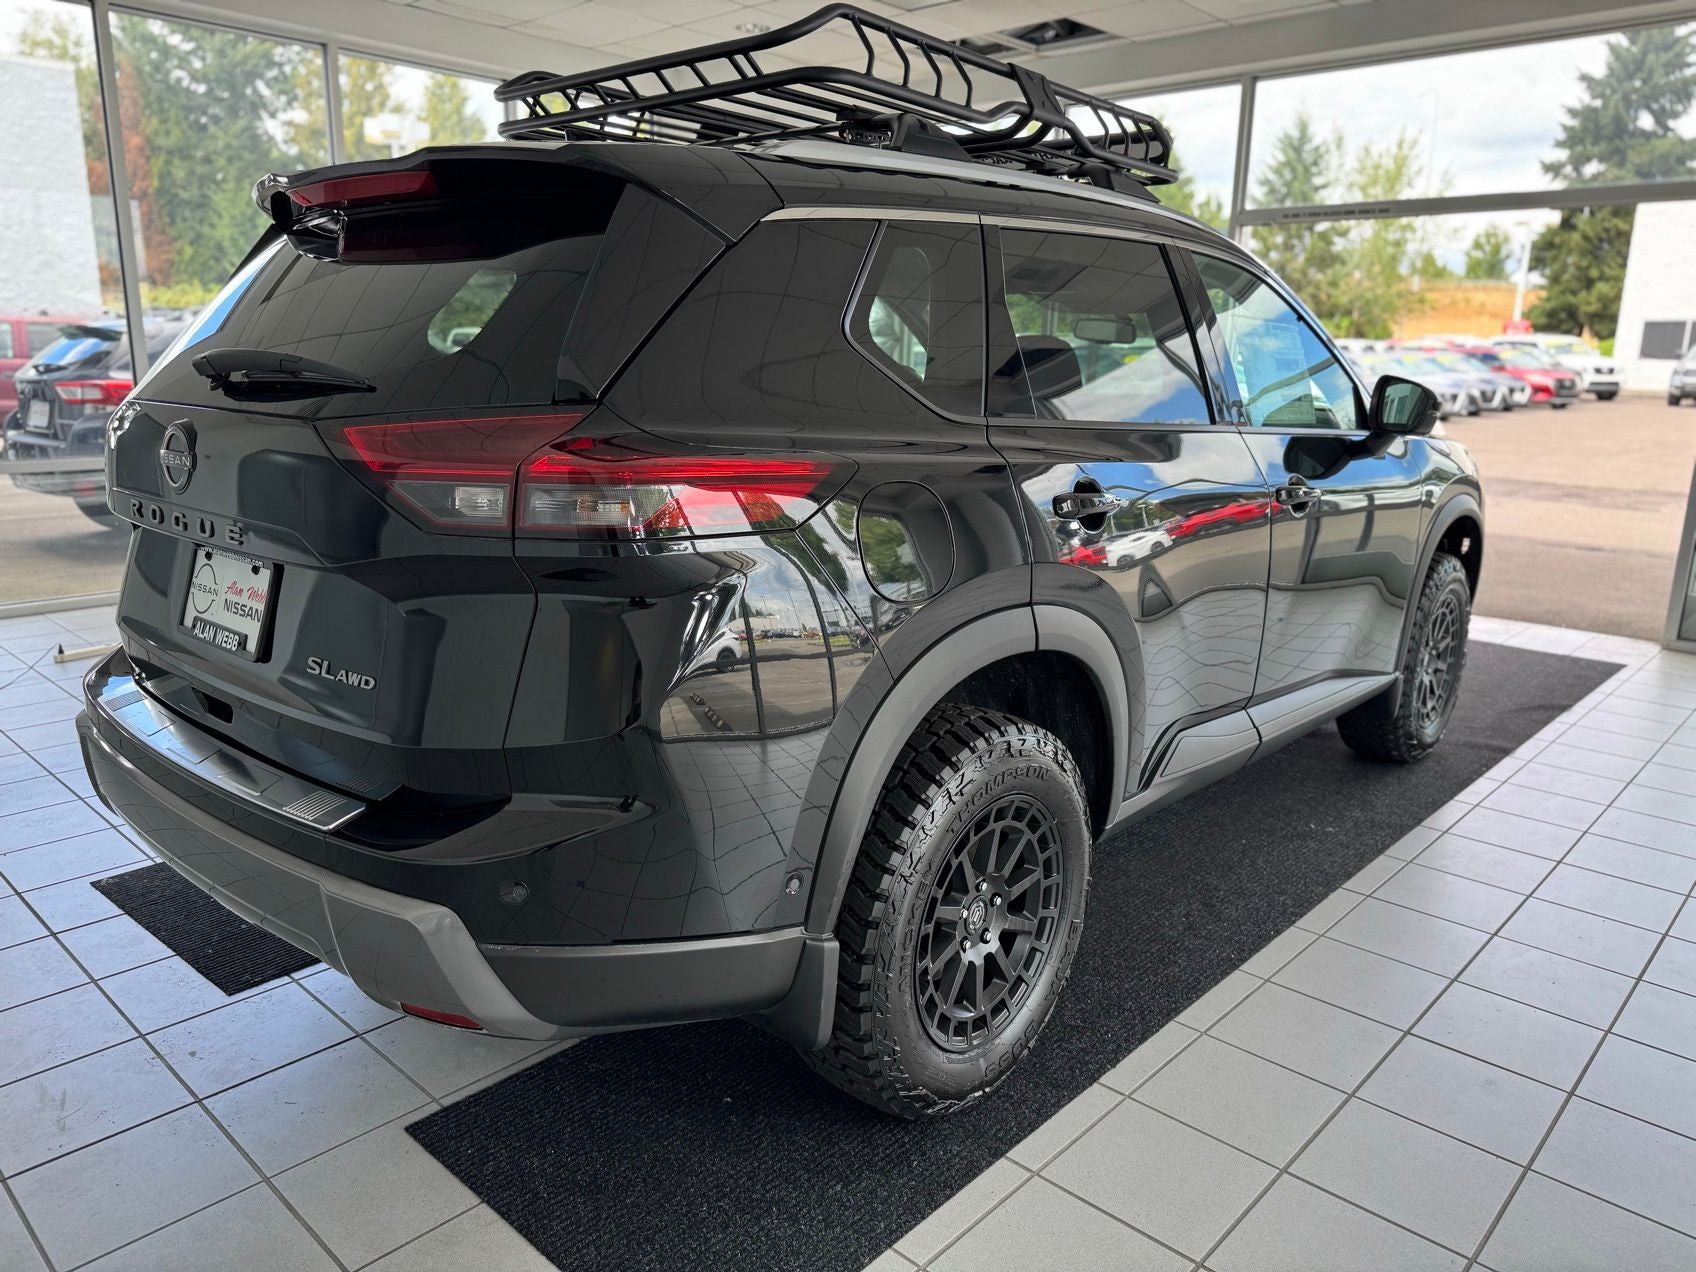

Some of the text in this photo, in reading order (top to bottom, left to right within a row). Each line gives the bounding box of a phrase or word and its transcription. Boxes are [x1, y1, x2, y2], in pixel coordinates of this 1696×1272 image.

[161, 452, 190, 467] SSAN
[130, 499, 245, 546] ROGUE
[192, 581, 219, 597] NISSAN
[225, 580, 244, 598] Alan
[223, 598, 263, 622] NISSAN
[193, 621, 240, 651] ALAN WEBB
[306, 656, 376, 690] SL AWD
[945, 764, 1051, 836] THOMPSON
